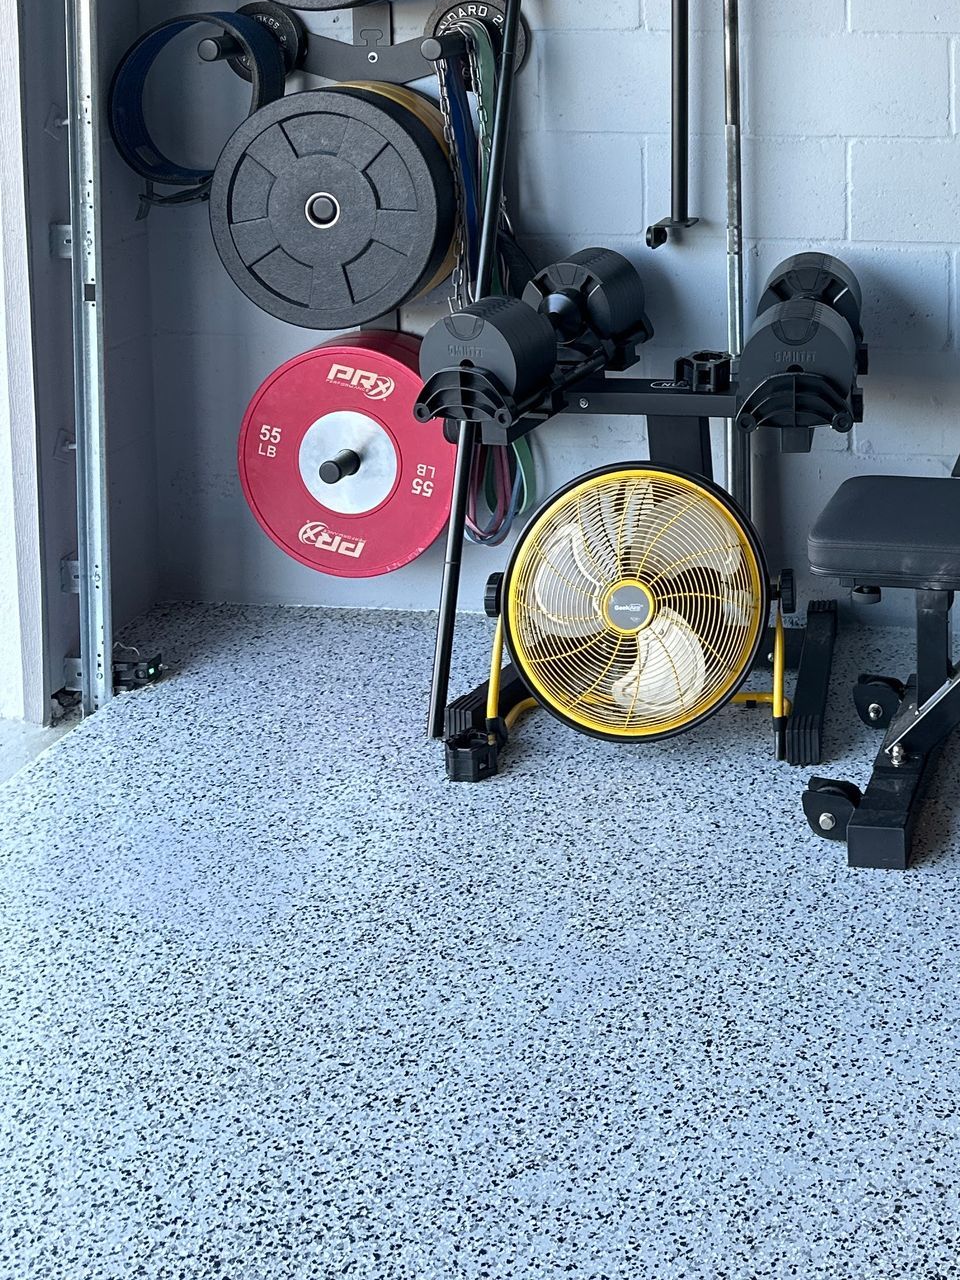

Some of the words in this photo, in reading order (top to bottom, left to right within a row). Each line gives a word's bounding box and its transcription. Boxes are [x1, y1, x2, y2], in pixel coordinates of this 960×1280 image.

[259, 424, 282, 444] 55
[258, 443, 277, 458] LB
[416, 463, 436, 479] LB
[411, 478, 435, 498] 55
